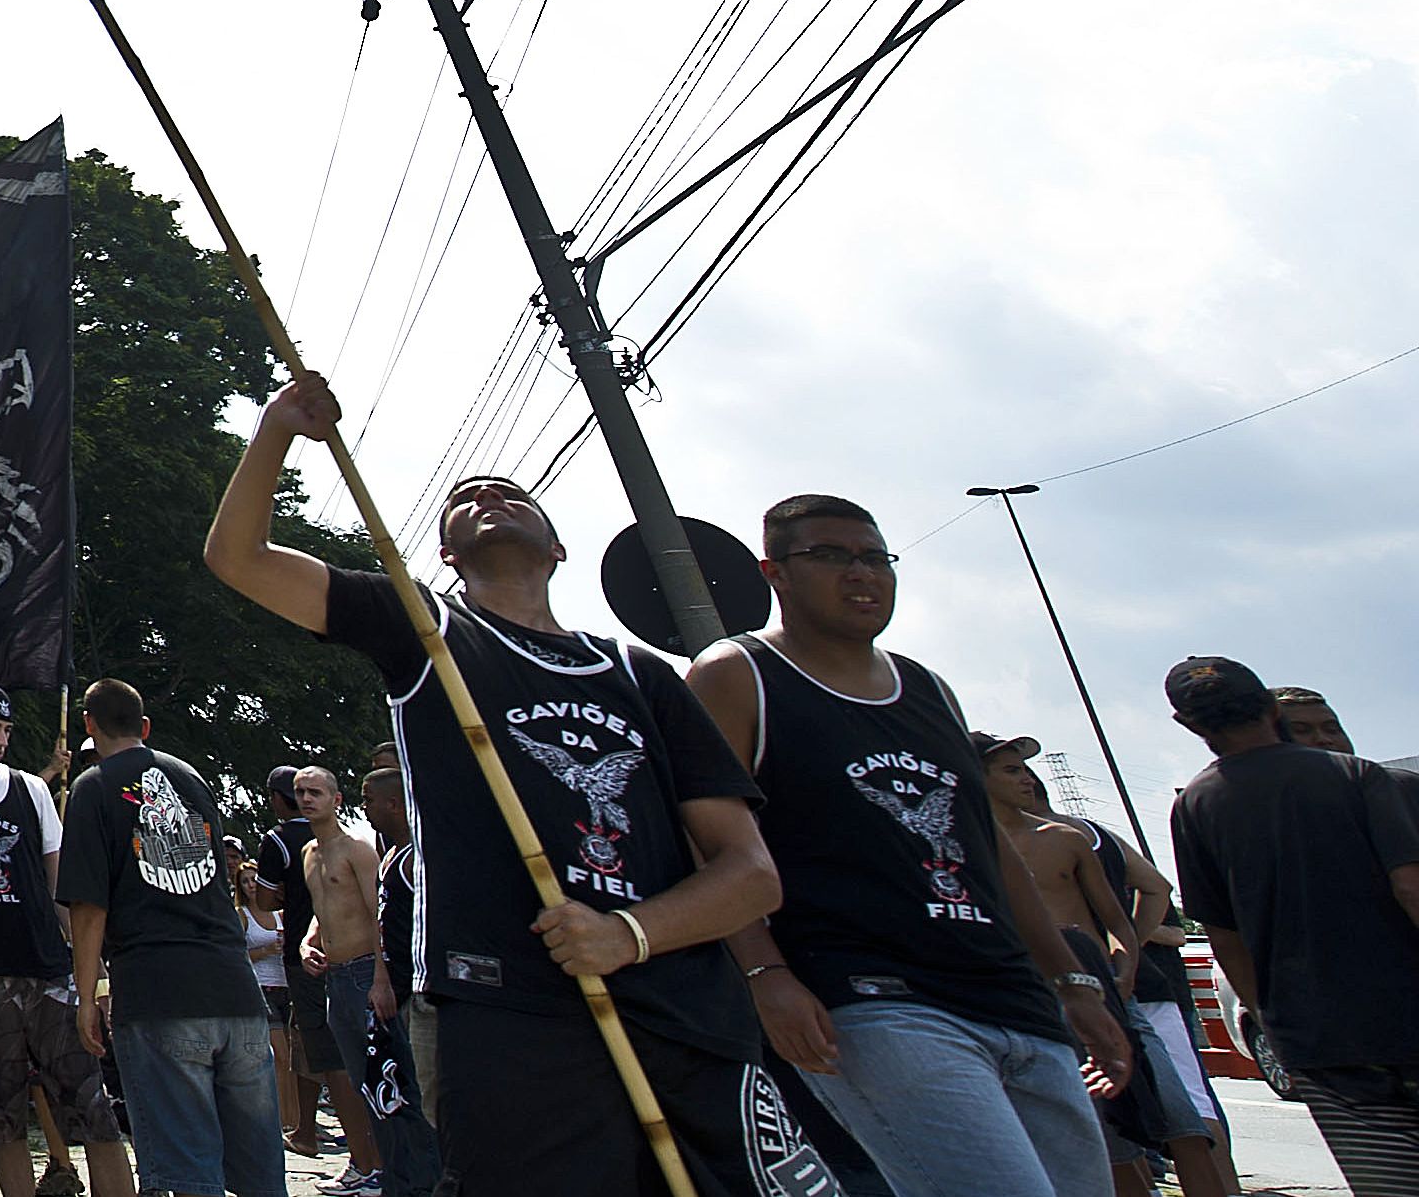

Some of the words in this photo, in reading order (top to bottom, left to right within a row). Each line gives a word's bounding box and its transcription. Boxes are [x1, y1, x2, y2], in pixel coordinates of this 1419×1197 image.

[505, 701, 645, 750] GAVIÕES
[561, 729, 599, 752] DA
[845, 750, 960, 789] GAVIÕES
[891, 779, 924, 796] DA
[138, 849, 217, 895] GAVIÕES
[566, 864, 644, 903] FIEL
[926, 902, 994, 924] FIEL
